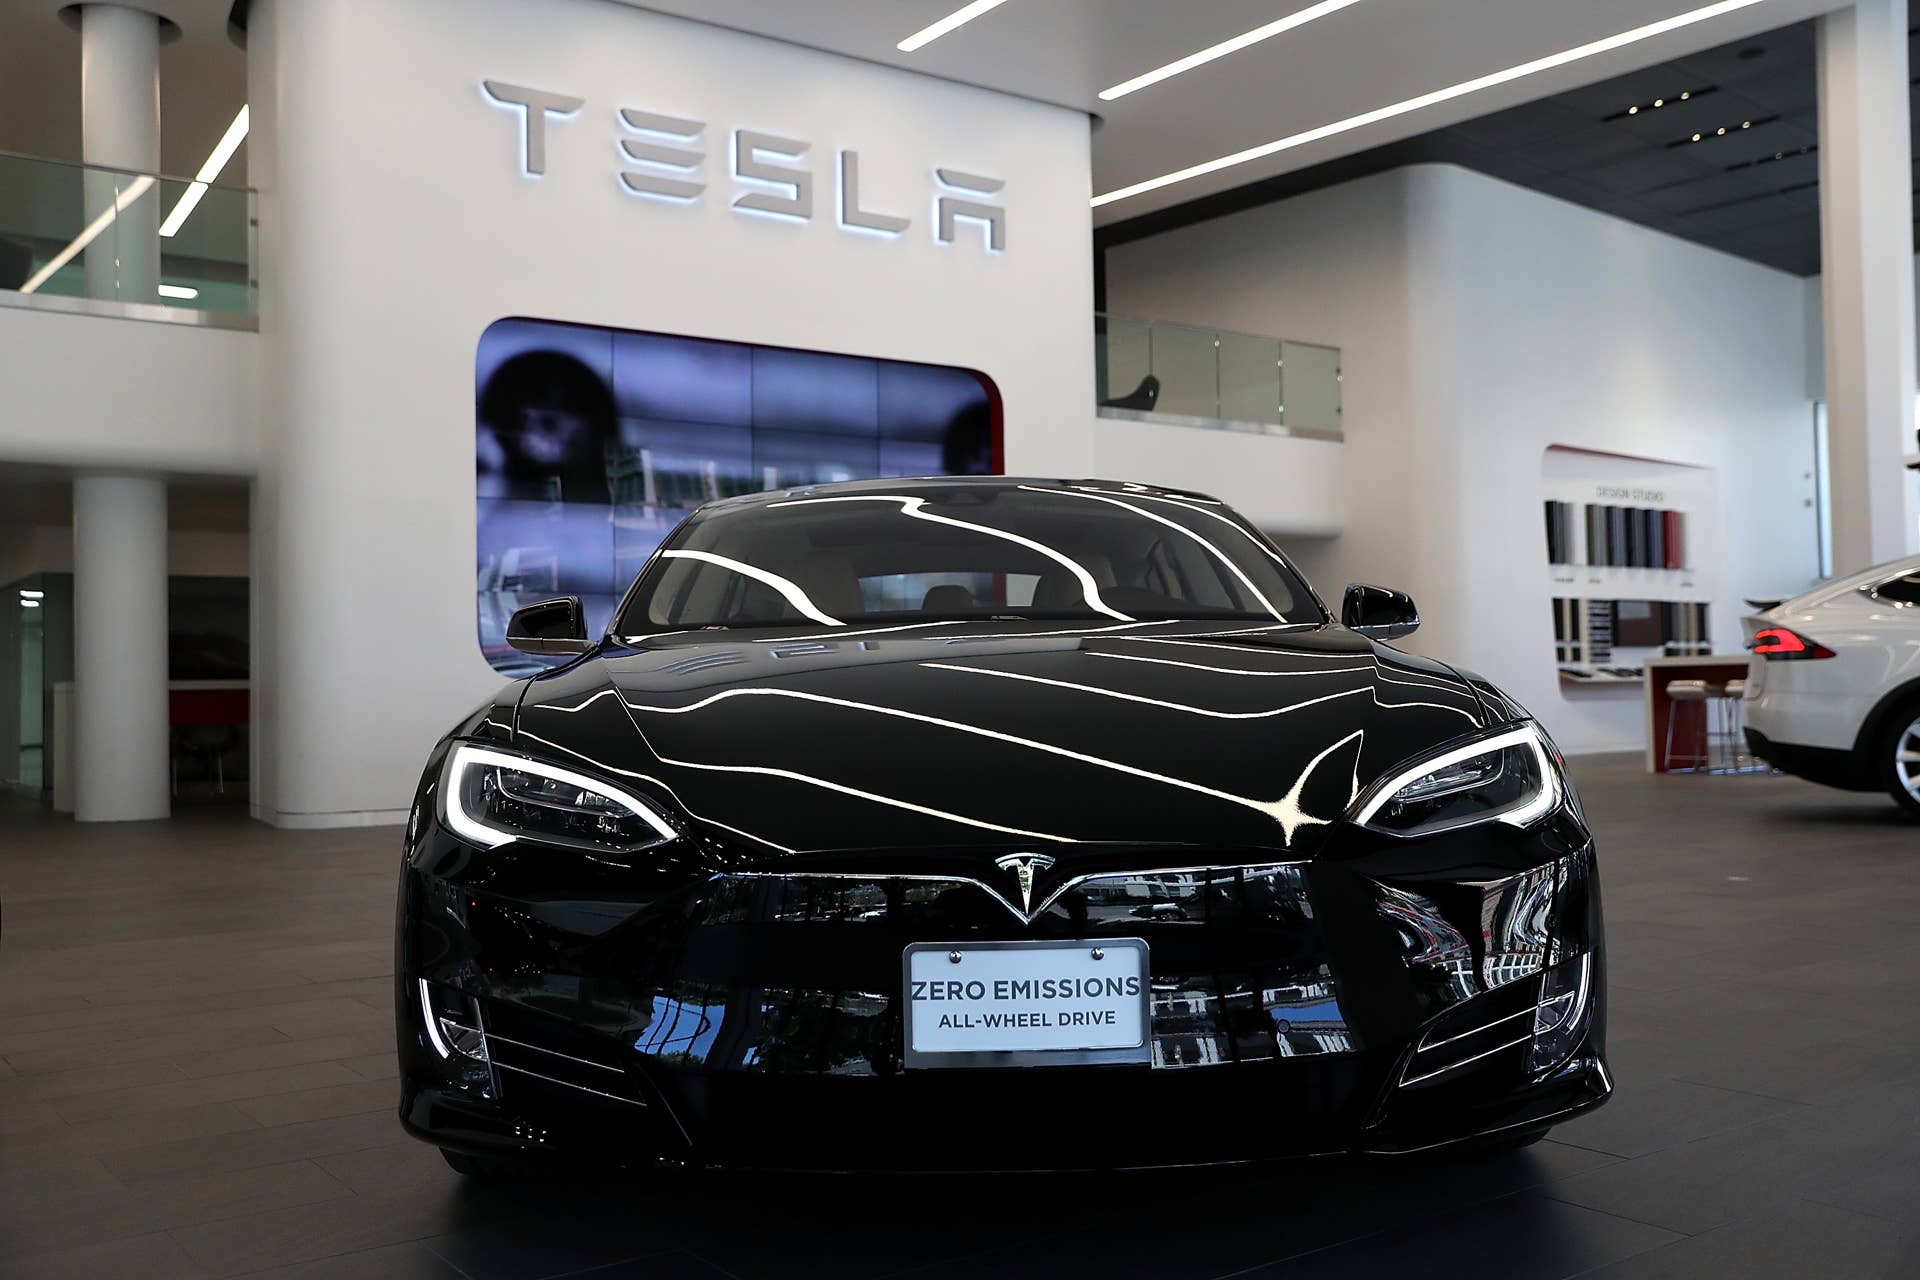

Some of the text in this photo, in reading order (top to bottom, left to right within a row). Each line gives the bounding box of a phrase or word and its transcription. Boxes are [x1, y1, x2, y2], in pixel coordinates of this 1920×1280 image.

[480, 80, 1006, 252] TESLA
[1596, 486, 1664, 502] DESIGN STUDIO
[911, 976, 1141, 1000] ZERO EMISSIONS
[938, 1010, 1116, 1029] ALL-WHEEL DRIVE
